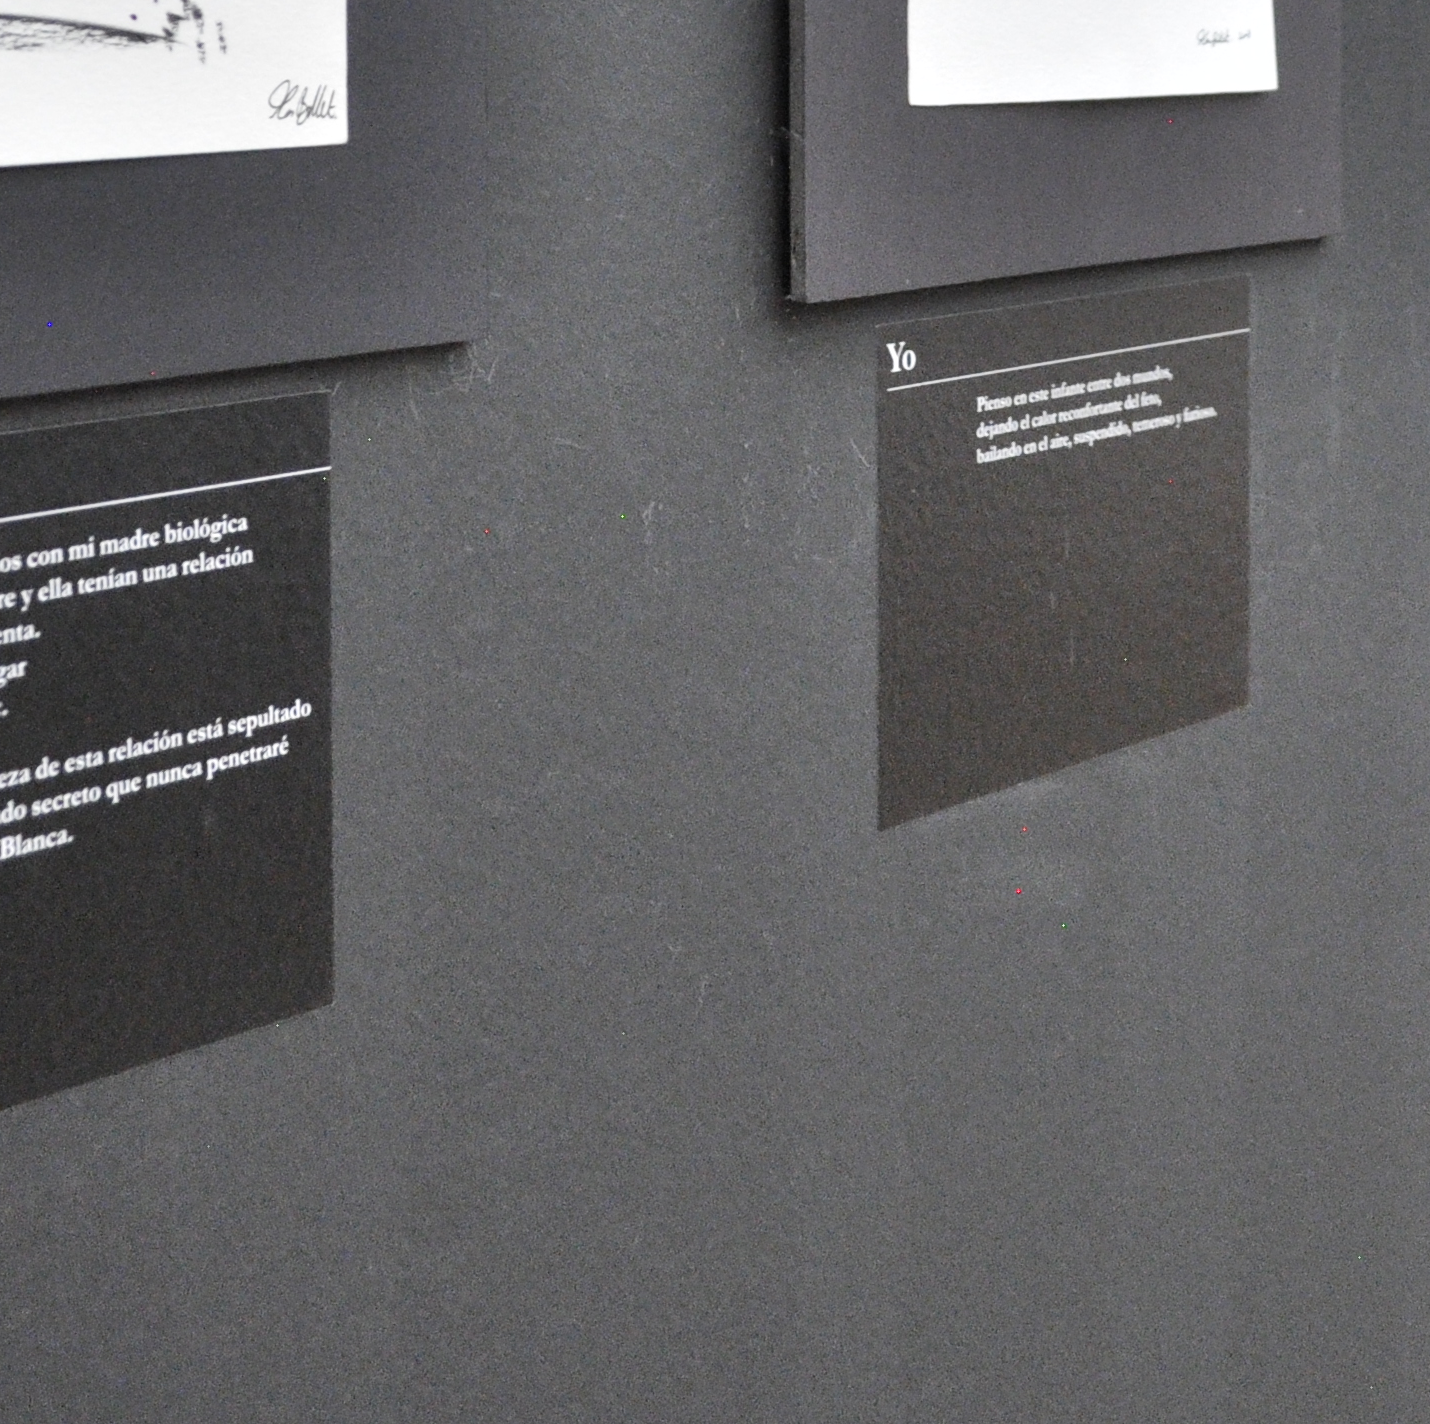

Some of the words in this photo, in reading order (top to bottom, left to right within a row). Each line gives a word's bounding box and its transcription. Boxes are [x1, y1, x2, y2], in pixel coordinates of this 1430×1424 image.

[885, 341, 916, 372] Yo
[975, 416, 1018, 440] dejando
[1019, 414, 1030, 430] el
[1031, 411, 1057, 427] calor
[1123, 394, 1139, 410] del
[976, 396, 1012, 412] Pienso
[1013, 394, 1027, 405] en
[1112, 373, 1131, 387] dos
[976, 442, 1022, 463] bailando
[1022, 442, 1037, 454] en
[1037, 435, 1048, 451] el
[1175, 414, 1182, 428] y
[25, 548, 64, 568] con
[67, 536, 95, 561] mi
[98, 528, 160, 555] madre
[163, 514, 248, 543] biológica
[20, 589, 33, 611] y
[36, 577, 73, 602] ella
[77, 568, 138, 594] tenían
[141, 563, 178, 582] una
[181, 546, 253, 575] relación
[34, 757, 60, 779] de
[63, 751, 104, 773] esta
[107, 730, 183, 763] relación
[186, 717, 224, 744] está
[227, 699, 312, 737] sepultado
[30, 787, 102, 816] secreto
[104, 777, 141, 804] que
[145, 762, 203, 788] nunca
[205, 735, 289, 780] penetraré
